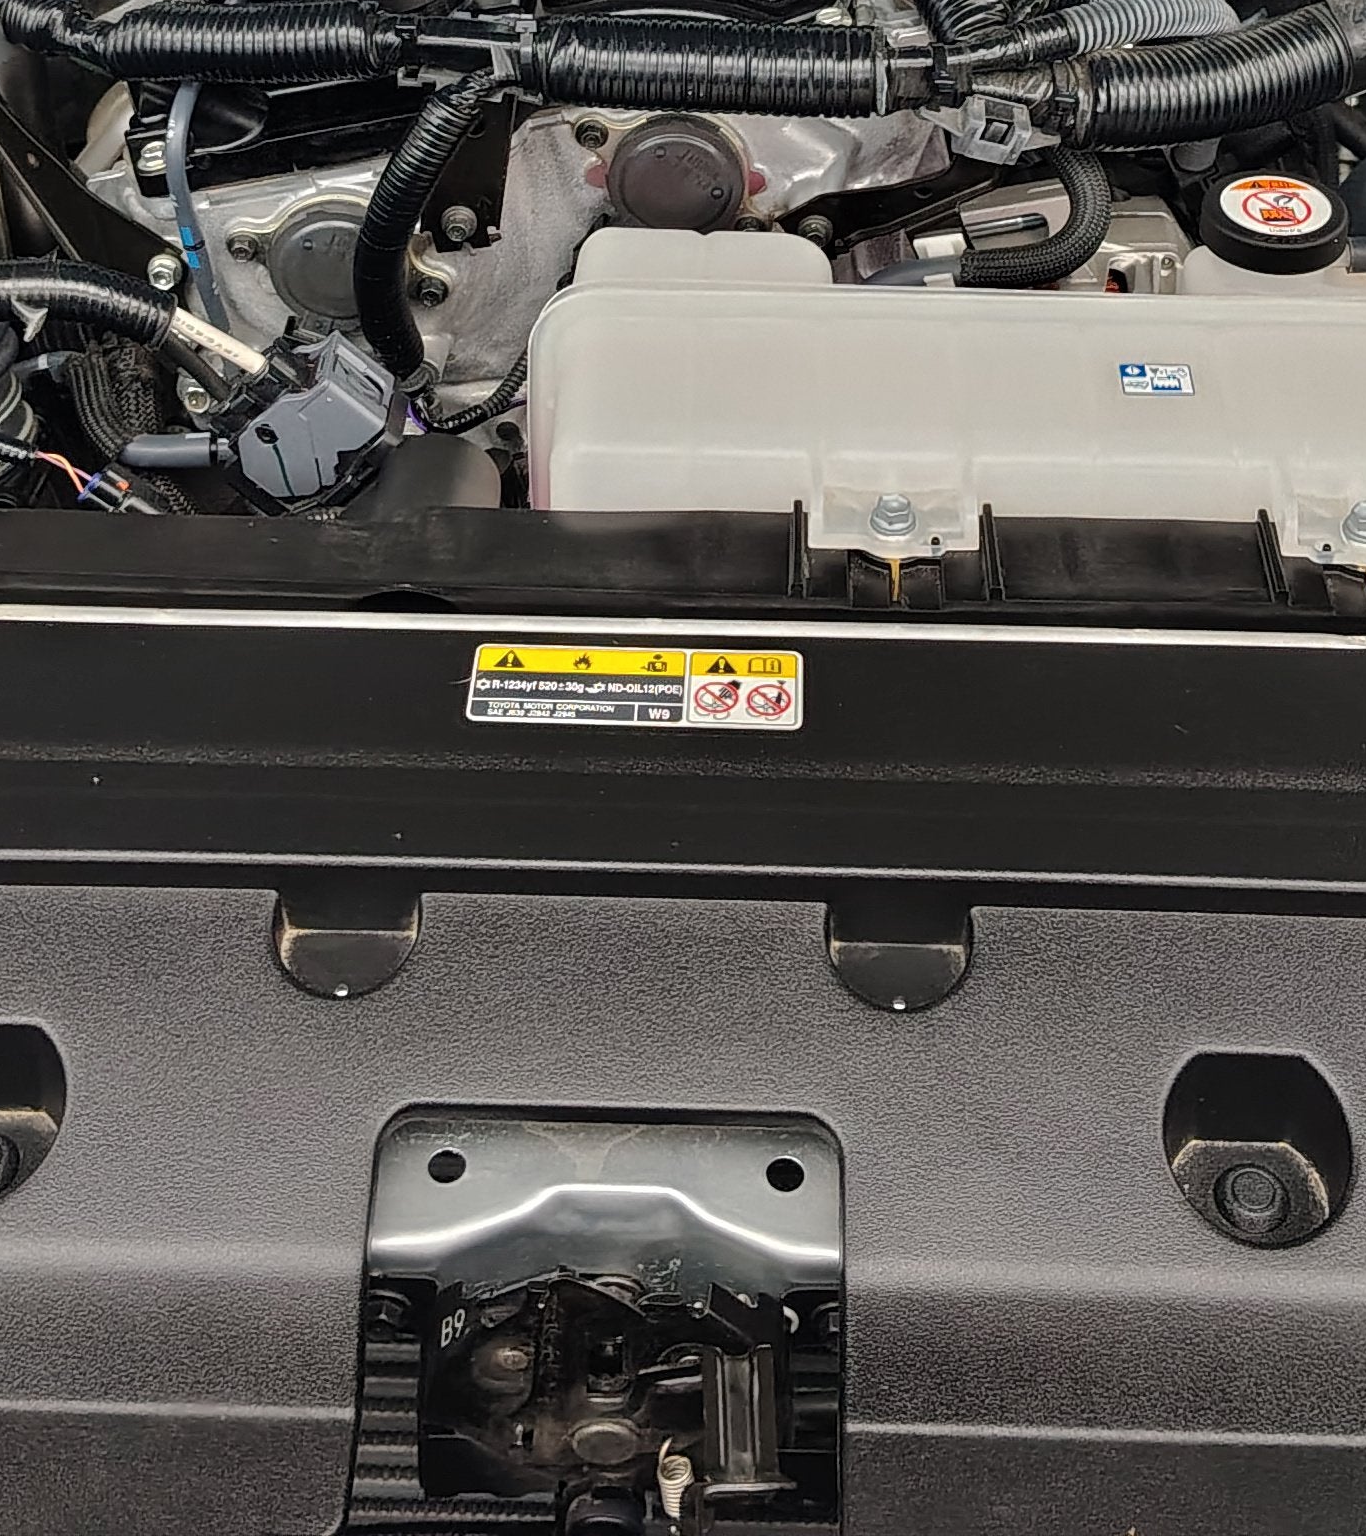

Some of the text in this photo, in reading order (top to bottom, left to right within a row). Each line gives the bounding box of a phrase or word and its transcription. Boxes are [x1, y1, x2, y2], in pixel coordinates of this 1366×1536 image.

[488, 701, 615, 713] TOYOTA MOTOR CORPORATION
[648, 708, 671, 720] W9
